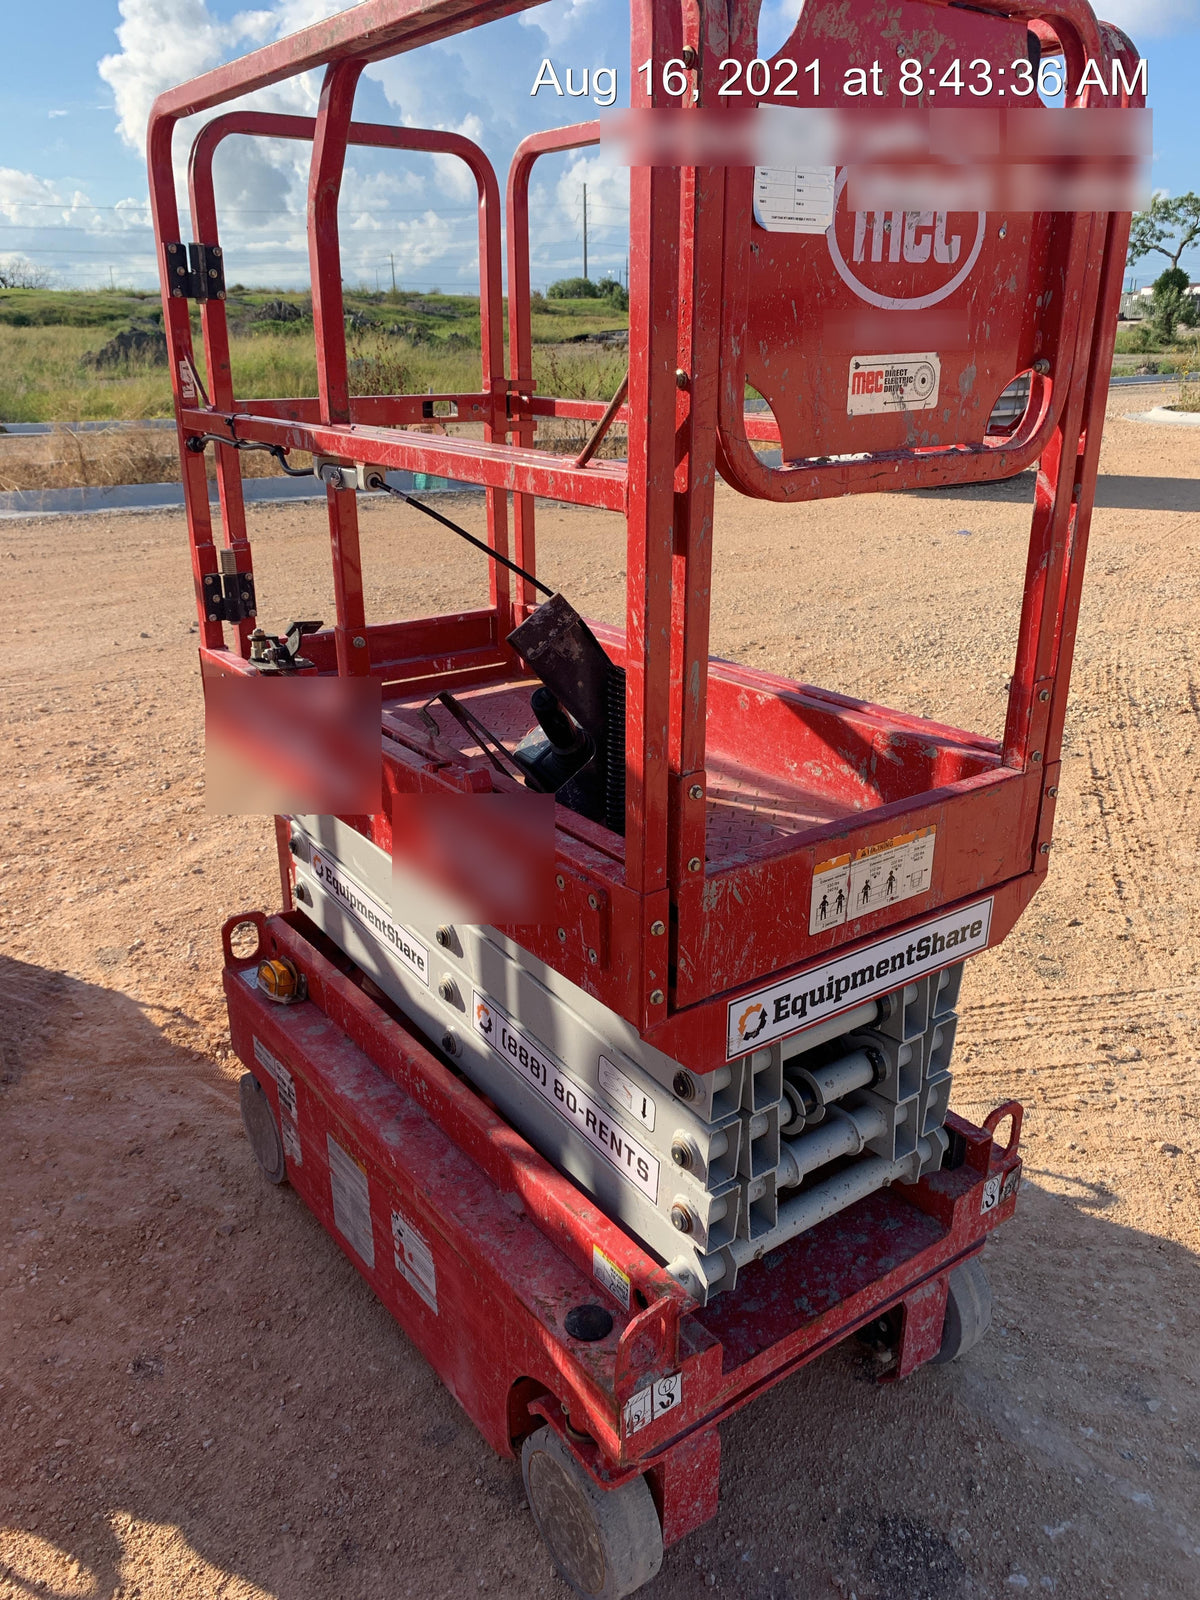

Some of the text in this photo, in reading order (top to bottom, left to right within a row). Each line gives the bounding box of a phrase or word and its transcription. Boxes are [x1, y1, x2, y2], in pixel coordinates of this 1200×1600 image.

[851, 370, 884, 396] mec
[884, 376, 914, 386] ELECTRIC
[885, 368, 908, 378] DIRECT
[325, 866, 425, 972] EquipmentShare
[773, 919, 982, 1024] EquipmentShare
[502, 1028, 649, 1182] (888) 80-RENTS
